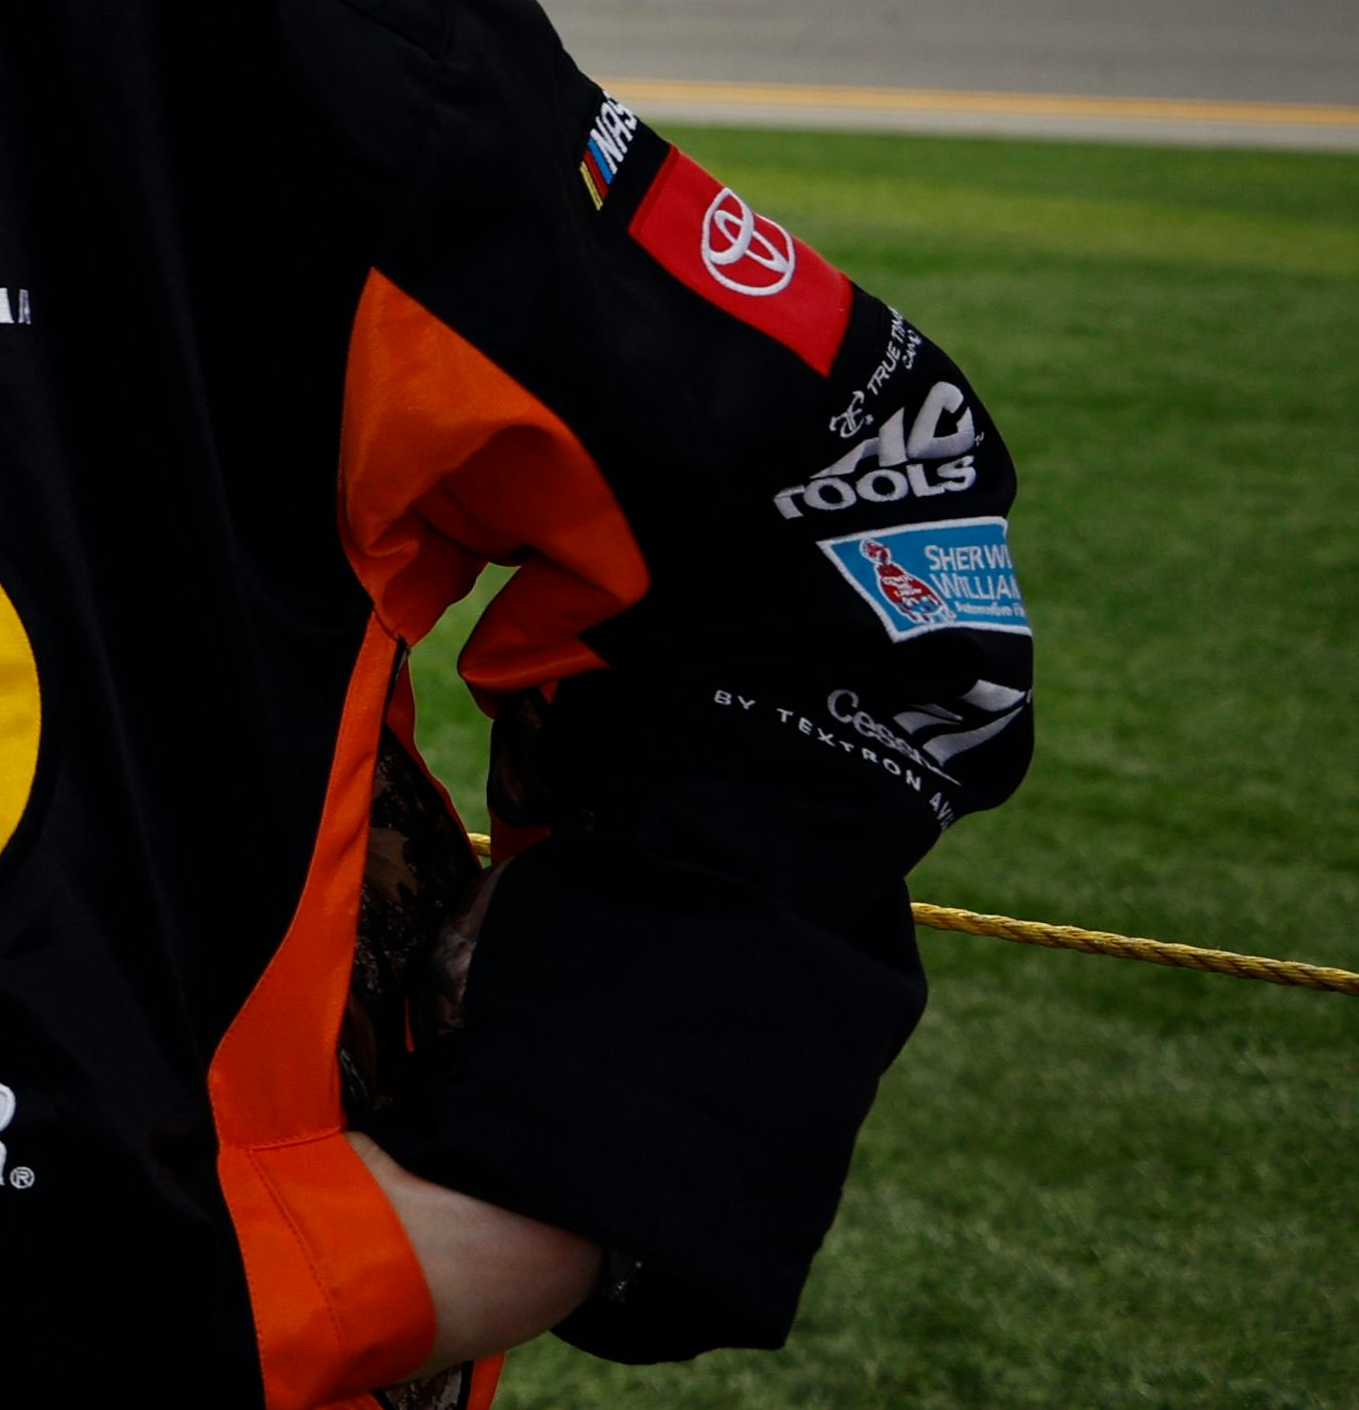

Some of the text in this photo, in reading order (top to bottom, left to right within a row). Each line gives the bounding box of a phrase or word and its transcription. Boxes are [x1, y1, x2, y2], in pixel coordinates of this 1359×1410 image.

[867, 347, 897, 396] TRUE
[773, 455, 977, 520] TOOLS
[713, 689, 756, 710] BY
[776, 707, 922, 790] TEXTRON
